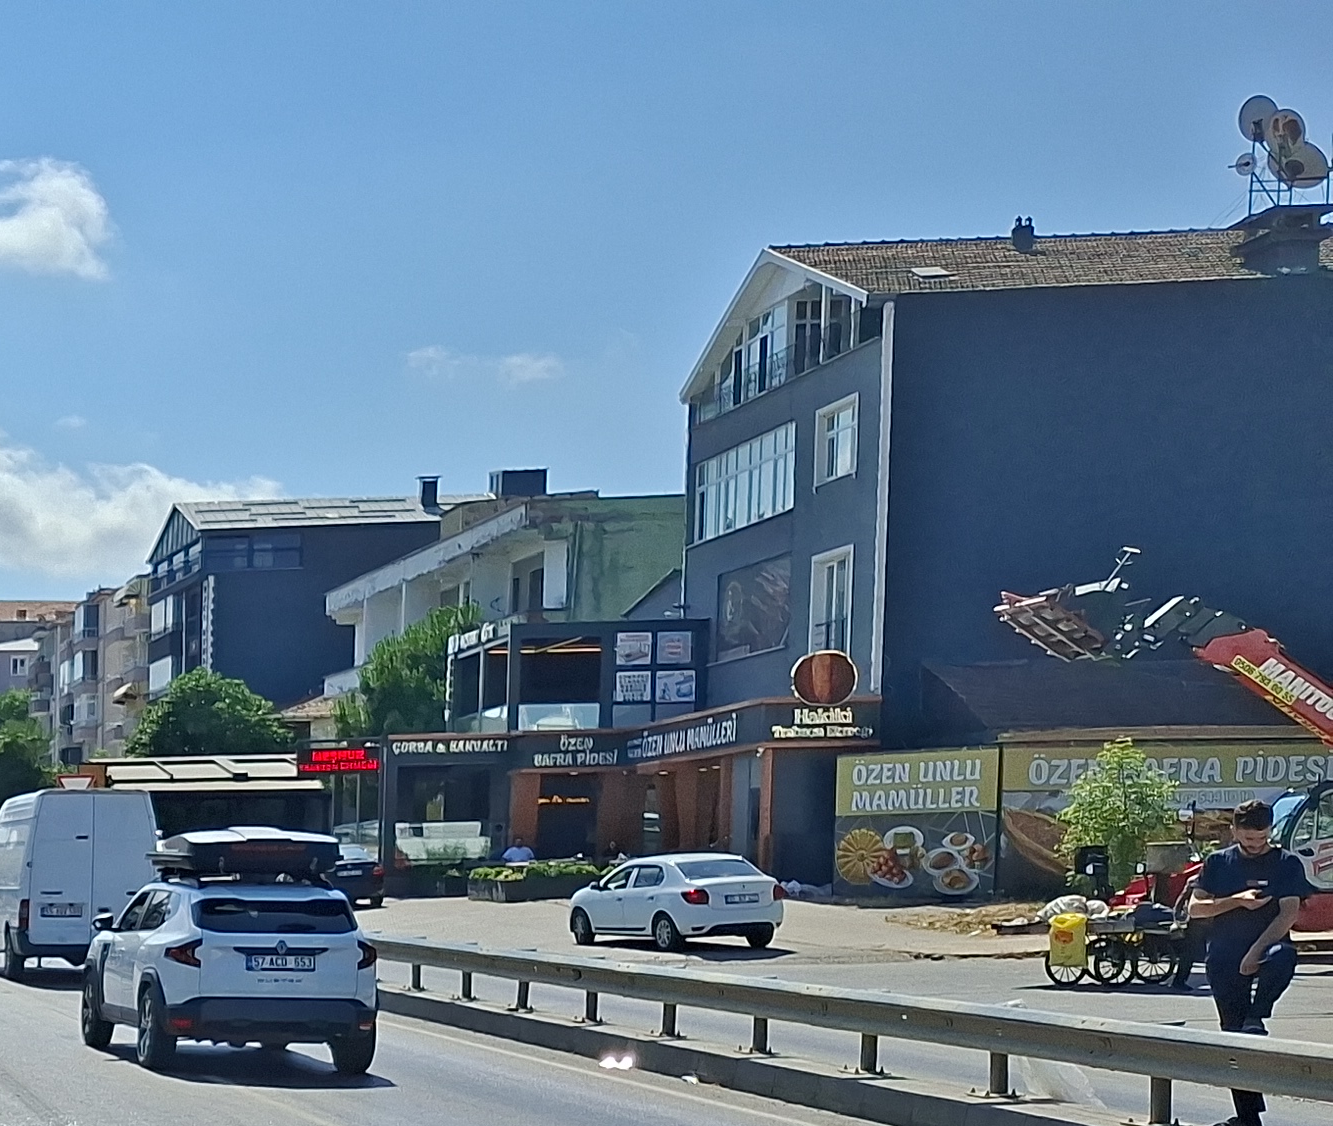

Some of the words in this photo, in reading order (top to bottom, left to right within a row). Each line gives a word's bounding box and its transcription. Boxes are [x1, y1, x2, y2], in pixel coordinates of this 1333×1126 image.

[794, 707, 853, 724] Hakiki
[560, 734, 593, 750] ÖZEN
[641, 731, 662, 758] ÖZEN
[533, 751, 572, 767] BAFRA
[577, 749, 617, 766] PİDESİ
[852, 760, 910, 785] ÖZEN
[919, 759, 981, 782] UNLU
[1129, 757, 1222, 784] AFRA
[851, 784, 980, 811] MAMÜLLER
[253, 956, 265, 967] 57
